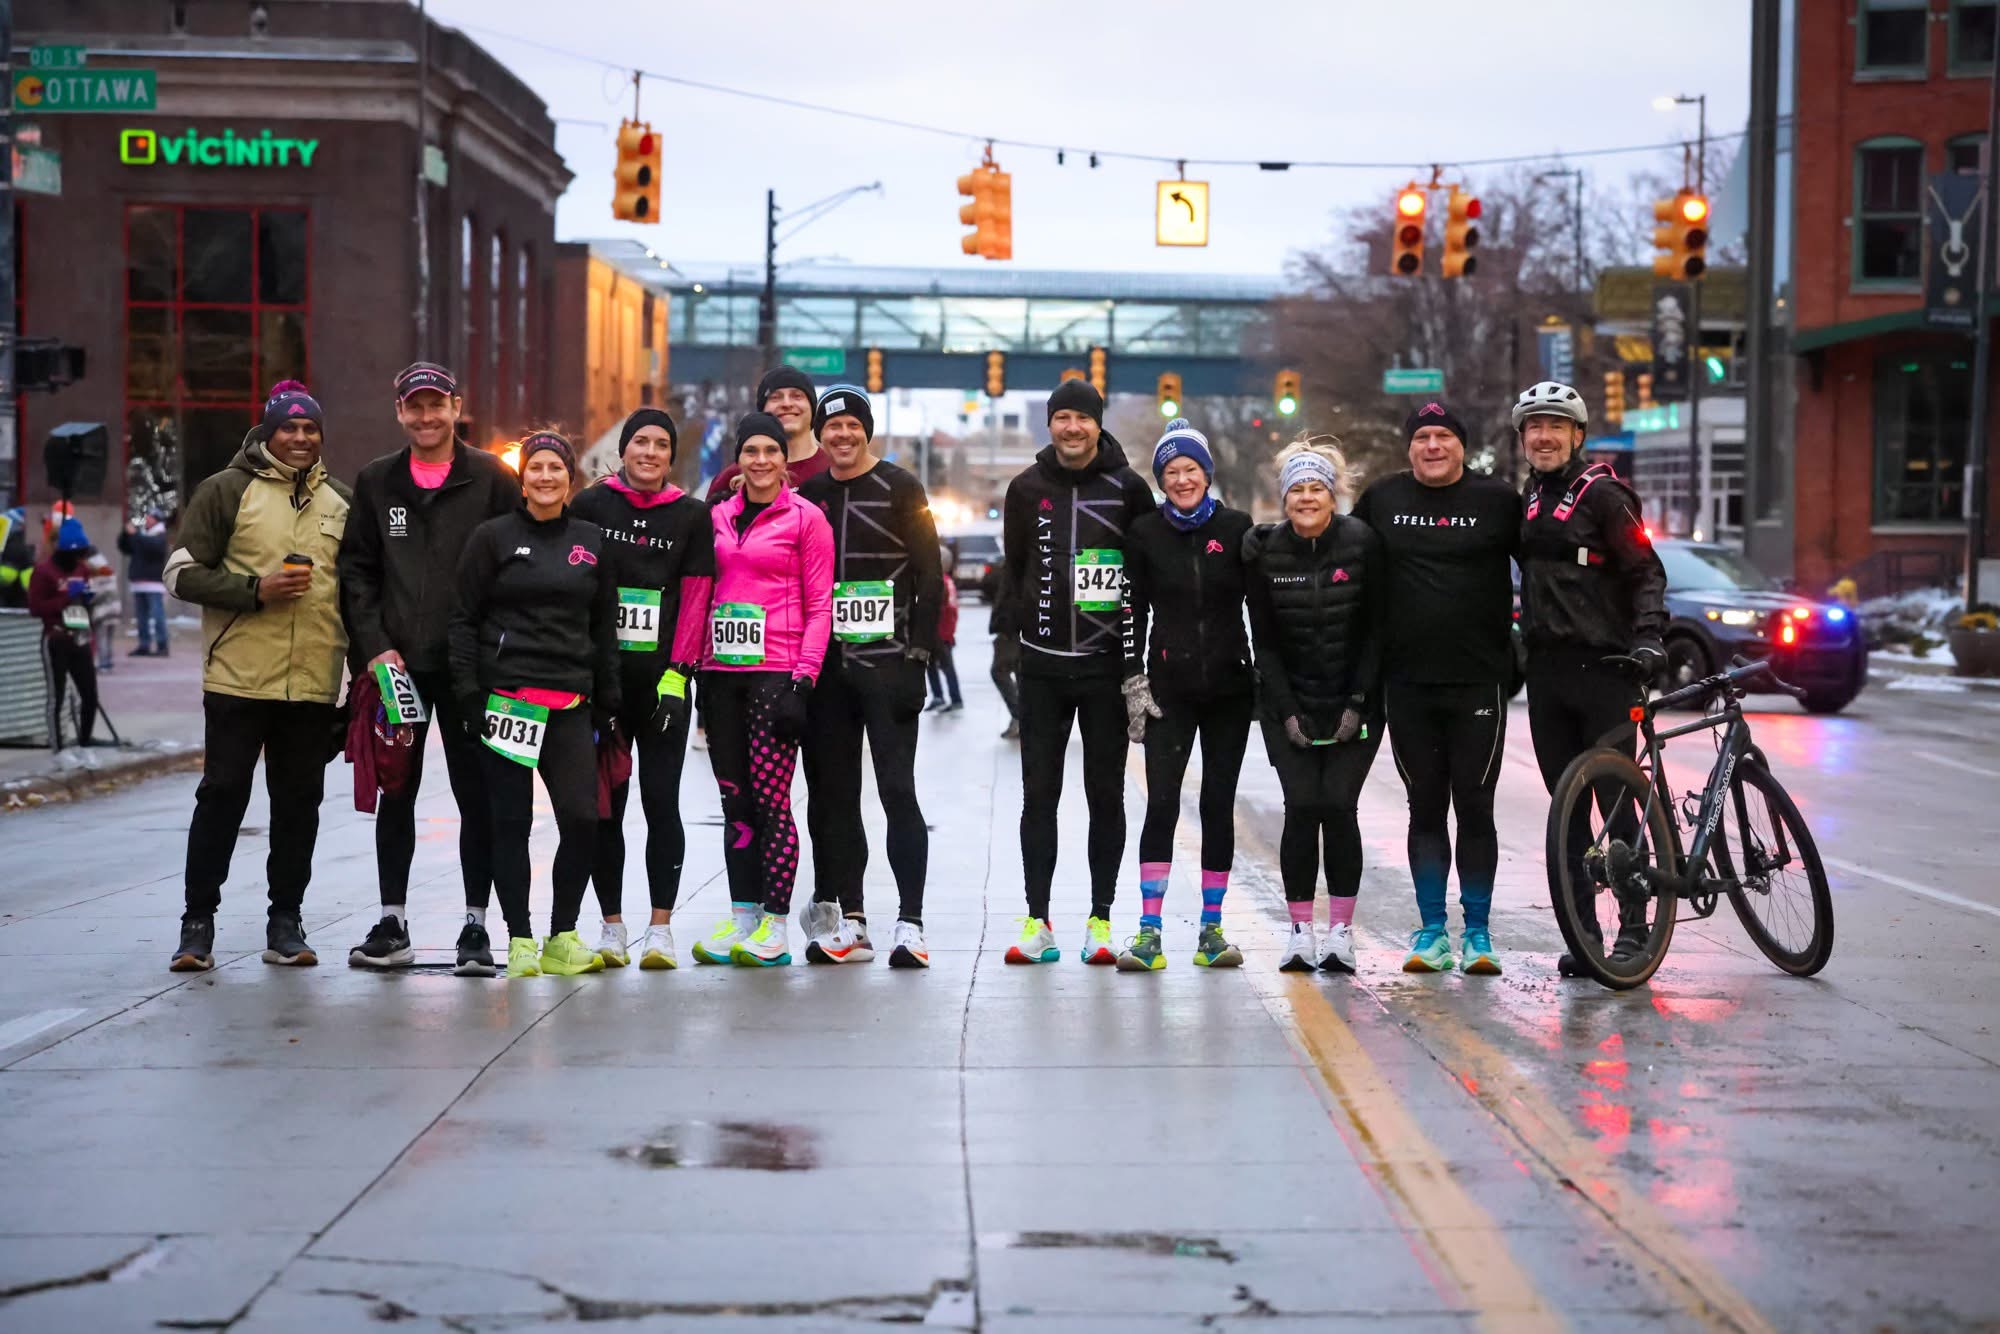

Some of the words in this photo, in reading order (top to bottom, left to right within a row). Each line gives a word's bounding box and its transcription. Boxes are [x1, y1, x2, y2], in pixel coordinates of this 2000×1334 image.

[46, 77, 149, 104] OTTAWA
[389, 506, 407, 526] SR
[600, 527, 674, 550] TELLAFLY
[1038, 516, 1052, 636] STELLAFLY
[836, 599, 890, 623] 5097
[714, 621, 761, 645] 5096
[389, 666, 418, 719] 6027
[486, 714, 539, 747] 6031
